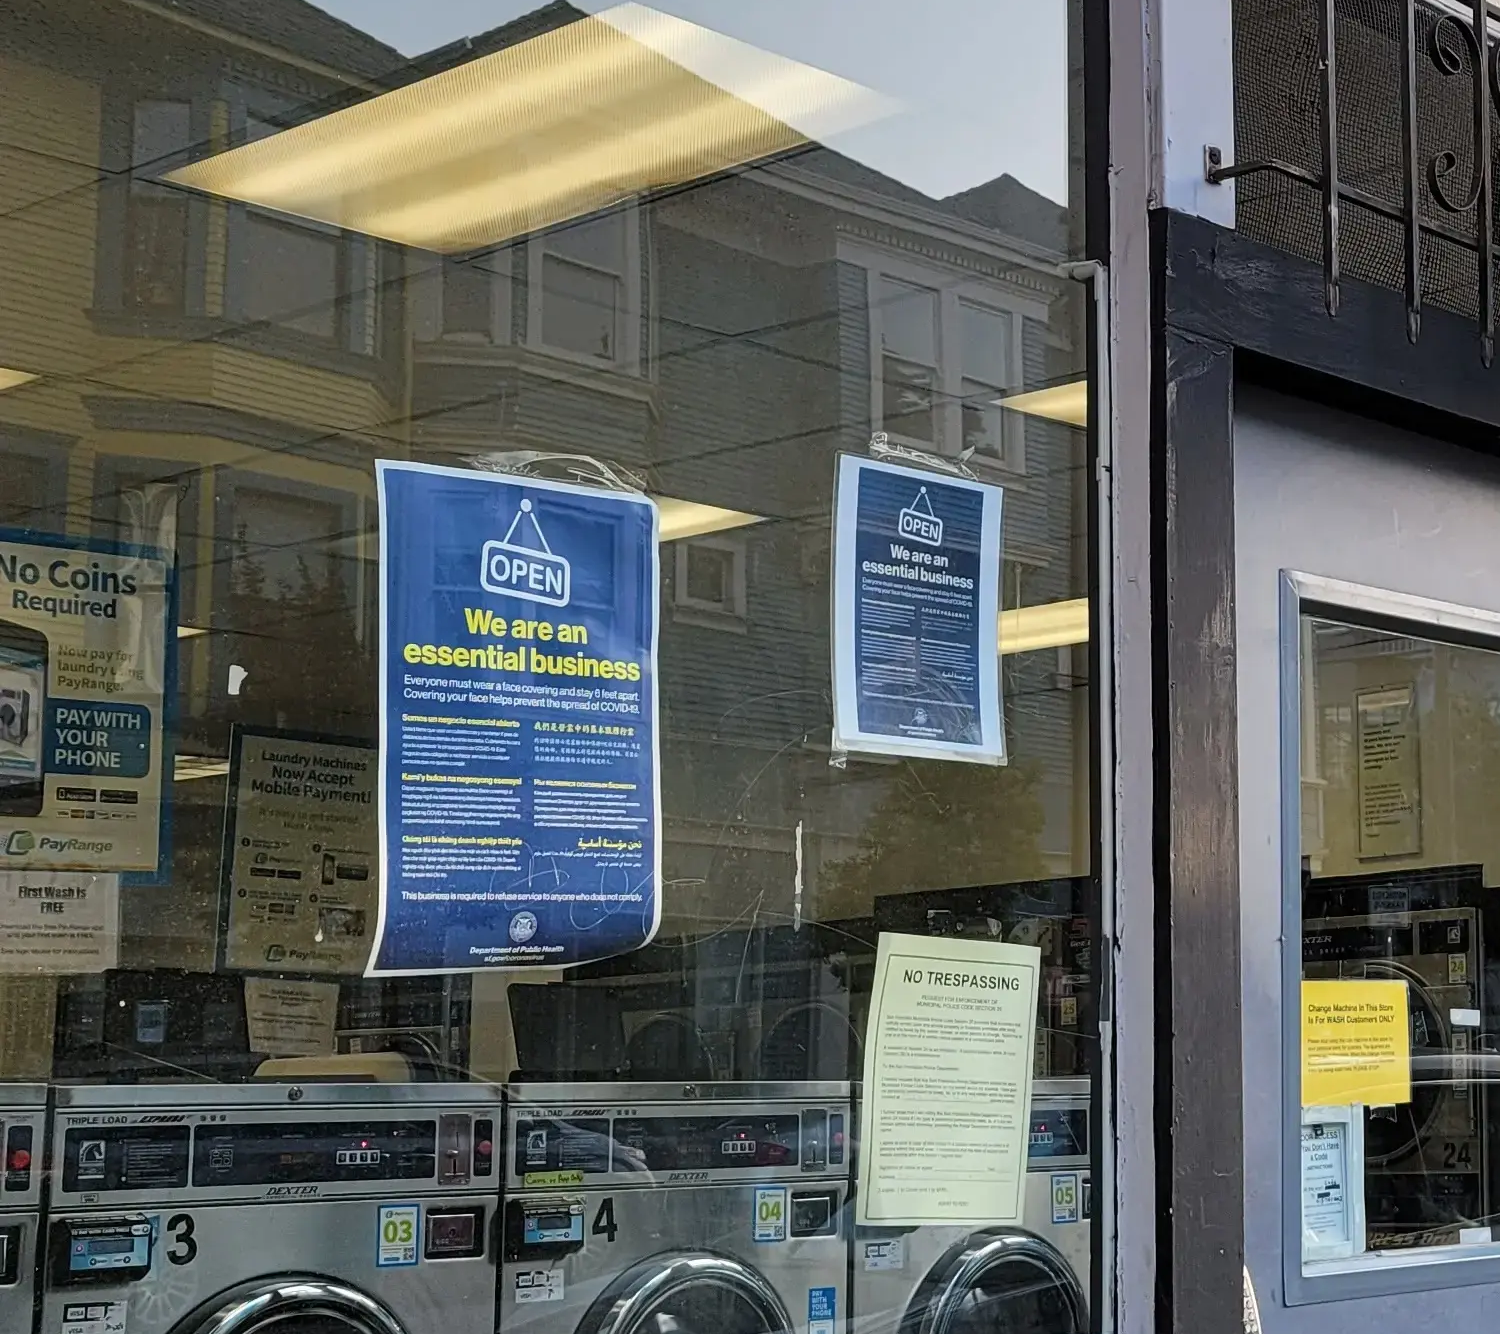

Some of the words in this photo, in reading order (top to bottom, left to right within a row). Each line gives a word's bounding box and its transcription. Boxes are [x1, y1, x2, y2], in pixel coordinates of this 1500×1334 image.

[903, 515, 938, 540] OPEN
[889, 543, 910, 561] We
[911, 552, 932, 565] are
[933, 555, 949, 567] an
[0, 554, 40, 585] No
[48, 560, 137, 596] Coins
[490, 555, 562, 595] OPEN
[862, 560, 919, 581] essential
[920, 567, 974, 590] business
[12, 588, 117, 619] Required
[464, 607, 508, 637] We
[511, 619, 554, 641] are
[557, 624, 588, 645] an
[90, 650, 113, 663] pay
[403, 643, 526, 672] essential
[530, 647, 640, 682] business
[57, 660, 108, 677] laundry
[403, 687, 446, 703] Covering
[446, 692, 468, 703] your
[468, 691, 489, 703] face
[488, 694, 513, 707] helps
[513, 697, 546, 708] prevent
[404, 673, 448, 688] Everyone
[448, 679, 472, 688] must
[472, 680, 496, 690] wear
[502, 681, 521, 693] face
[521, 684, 558, 697] covering
[559, 687, 576, 697] and
[576, 687, 594, 699] stay
[601, 689, 617, 700] feet
[55, 707, 91, 726] PAY
[93, 711, 140, 730] WITH
[55, 728, 109, 748] YOUR
[54, 748, 121, 768] PHONE
[261, 750, 311, 767] Laundry
[312, 755, 367, 772] Machines
[271, 765, 305, 780] Now
[307, 770, 355, 788] Accept
[251, 779, 300, 797] Mobile
[303, 784, 371, 804] Payment!
[39, 836, 113, 854] PayRange
[18, 885, 43, 899] First
[44, 886, 76, 899] Wash
[402, 890, 417, 901] This
[40, 901, 64, 914] FREE
[903, 969, 923, 984] NO
[927, 971, 1020, 992] TRESPASSING
[1308, 1004, 1332, 1014] Change
[1333, 1004, 1358, 1012] Machine
[1378, 1003, 1394, 1011] Store
[1314, 1016, 1325, 1024] For
[1326, 1015, 1345, 1024] WASH
[1346, 1015, 1378, 1024] Customers
[1378, 1015, 1395, 1023] ONLY
[66, 1116, 100, 1125] TRIPLE
[102, 1115, 128, 1124] LOAD
[542, 1109, 563, 1117] LOAD
[1443, 1142, 1472, 1169] 24
[668, 1171, 709, 1181] DEXTER
[266, 1185, 319, 1196] DEXTER
[1055, 1187, 1074, 1205] 05
[592, 1196, 618, 1243] 4
[759, 1201, 782, 1222] 04
[166, 1213, 198, 1266] 3
[383, 1219, 413, 1244] 03
